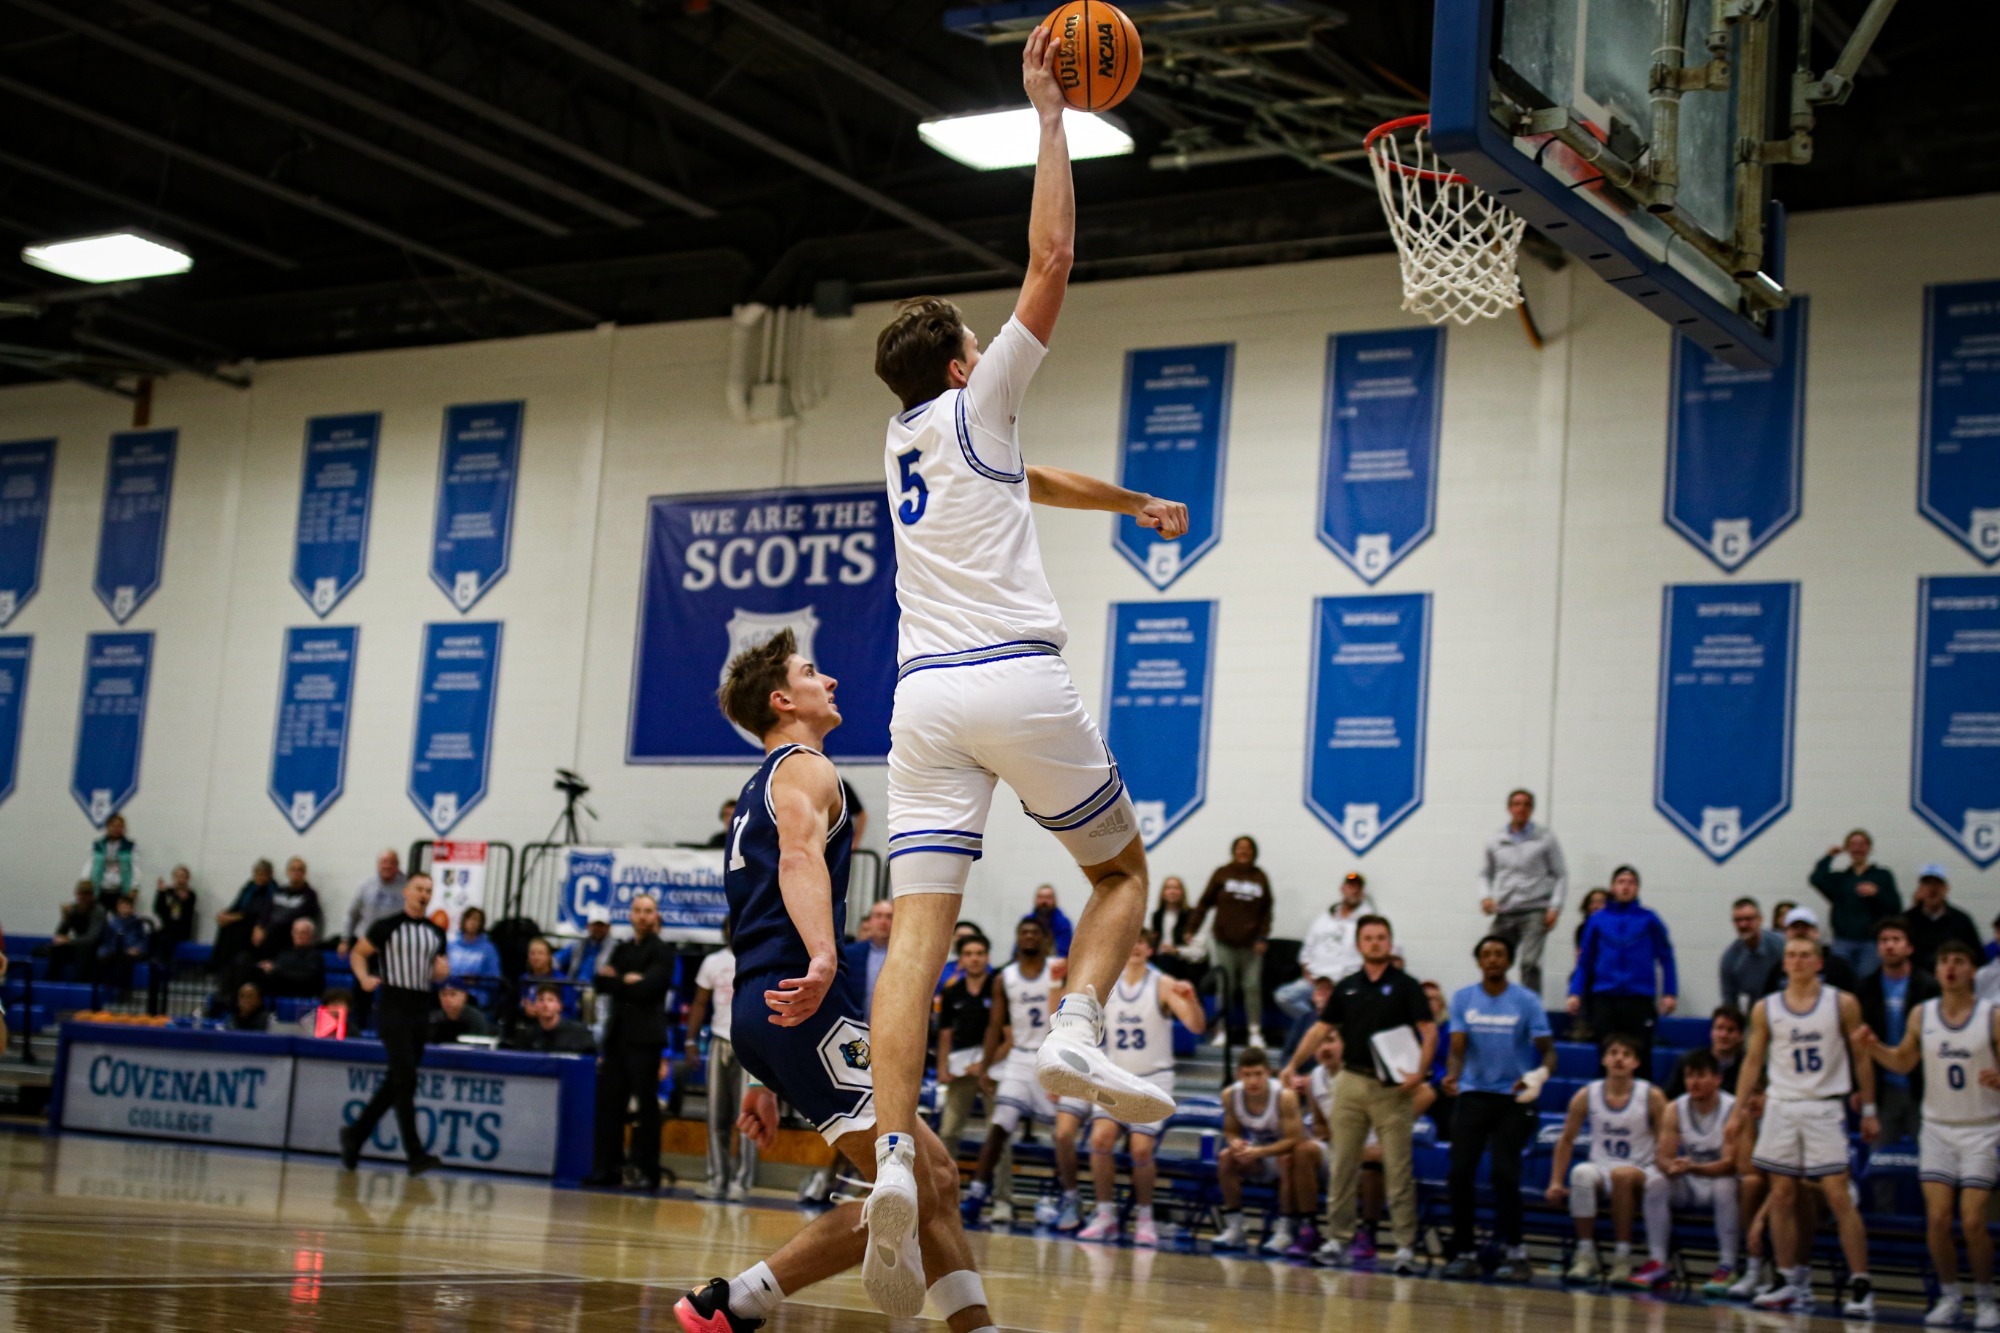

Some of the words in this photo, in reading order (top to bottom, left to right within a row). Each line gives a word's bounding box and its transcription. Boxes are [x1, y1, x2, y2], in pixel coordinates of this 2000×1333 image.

[1058, 13, 1080, 90] Wilson
[1098, 23, 1114, 78] NCAA
[897, 447, 929, 525] 5
[691, 509, 736, 535] WE
[743, 504, 804, 532] ARE
[812, 500, 878, 529] THE
[1722, 534, 1739, 557] C
[682, 533, 877, 591] SCOTS
[1157, 557, 1171, 576] C
[1365, 548, 1379, 569] C
[1089, 824, 1129, 838] adidas
[1353, 820, 1368, 840] C
[1711, 822, 1728, 846] C
[1974, 826, 1993, 850] C
[574, 875, 600, 916] C
[1029, 1008, 1043, 1027] 2
[1116, 1029, 1145, 1050] 23
[1793, 1048, 1822, 1073] 15
[89, 1055, 267, 1110] COVENANT
[1948, 1065, 1965, 1090] 0
[452, 1077, 504, 1105] THE
[128, 1106, 212, 1134] COLLEGE
